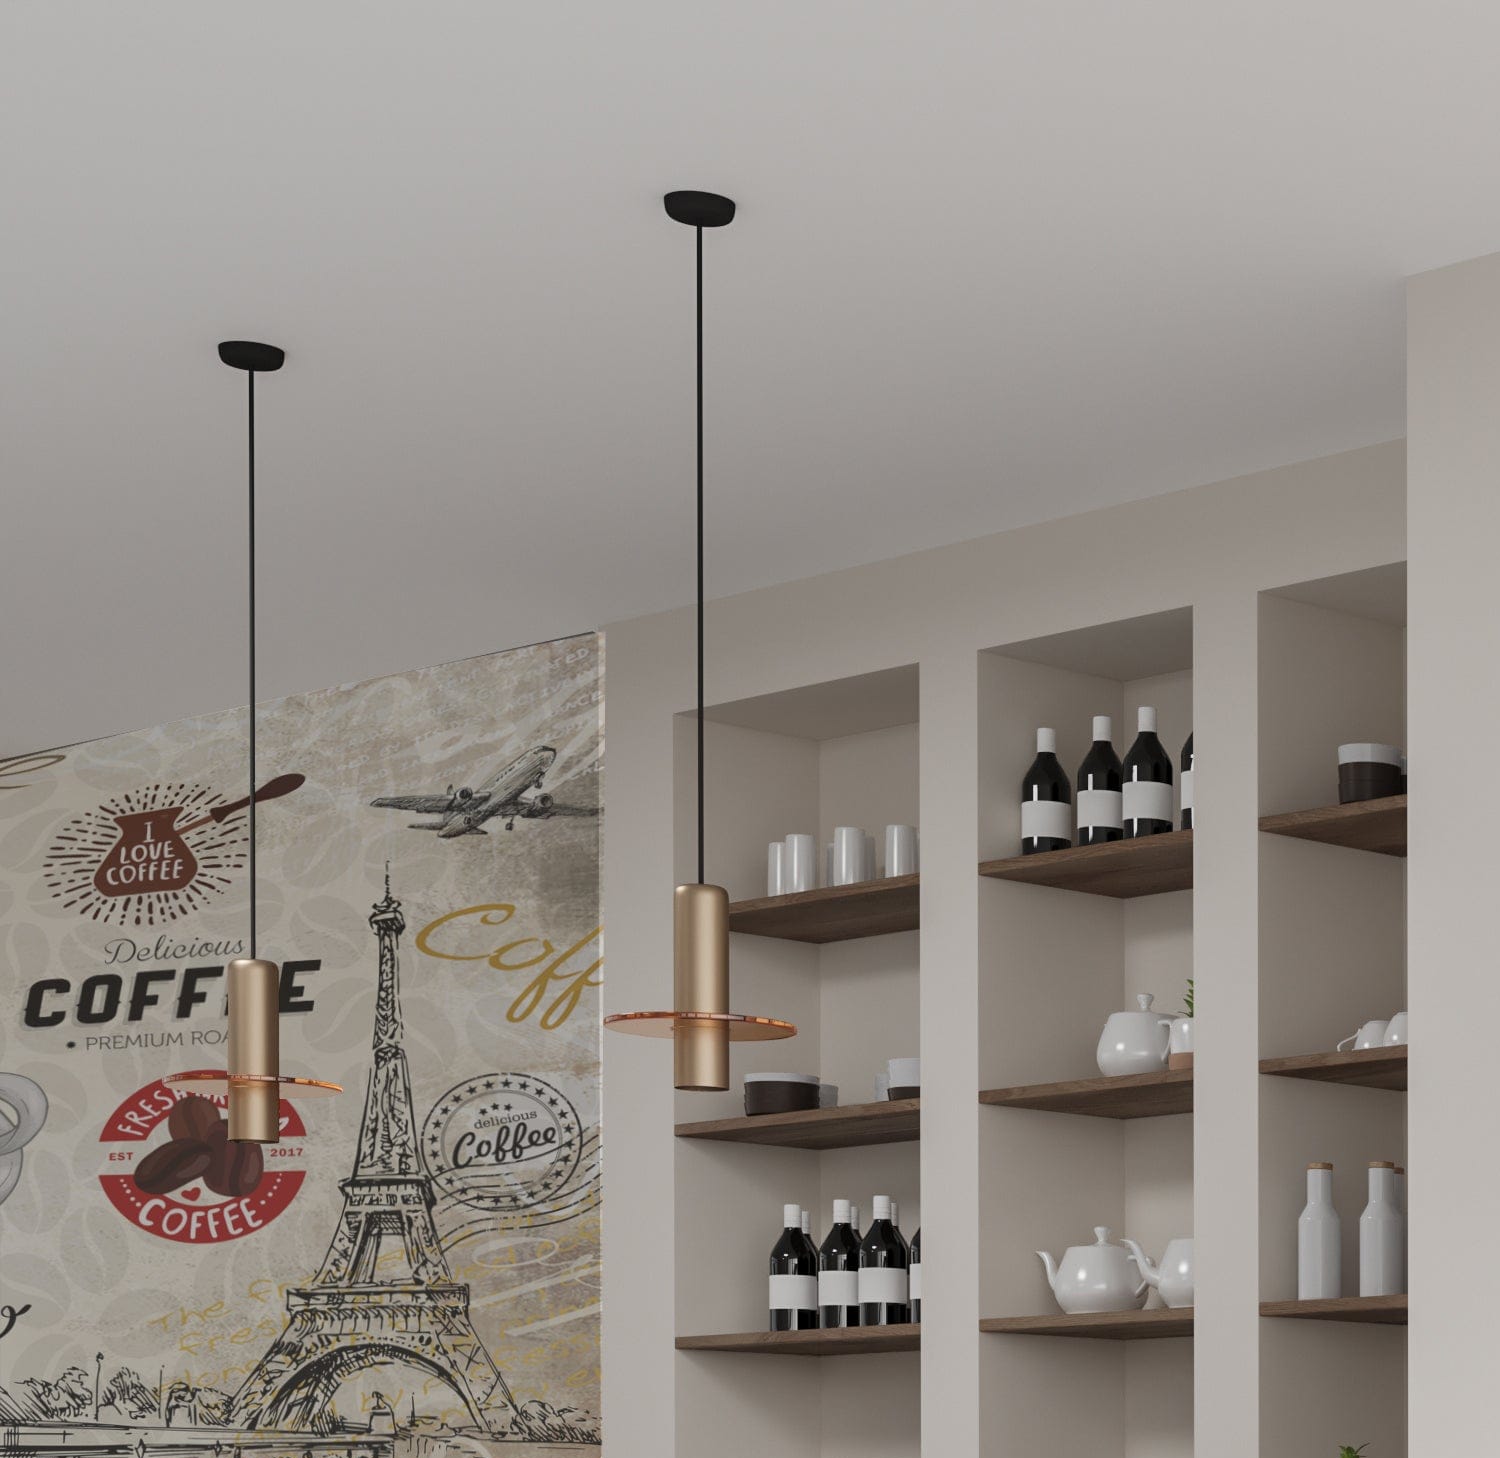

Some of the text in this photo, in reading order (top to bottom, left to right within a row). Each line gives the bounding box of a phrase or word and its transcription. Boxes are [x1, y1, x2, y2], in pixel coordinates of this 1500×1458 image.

[143, 821, 155, 843] I
[119, 840, 175, 864] LOVE
[106, 858, 184, 885] COFFEE
[104, 935, 245, 965] Delicious
[24, 959, 321, 1028] COFFE
[85, 1032, 184, 1051] PREMIUM
[474, 1109, 538, 1131] delicious
[109, 1148, 303, 1161] EST 2017
[452, 1121, 557, 1170] Coffee
[138, 1197, 262, 1240] COFFEE
